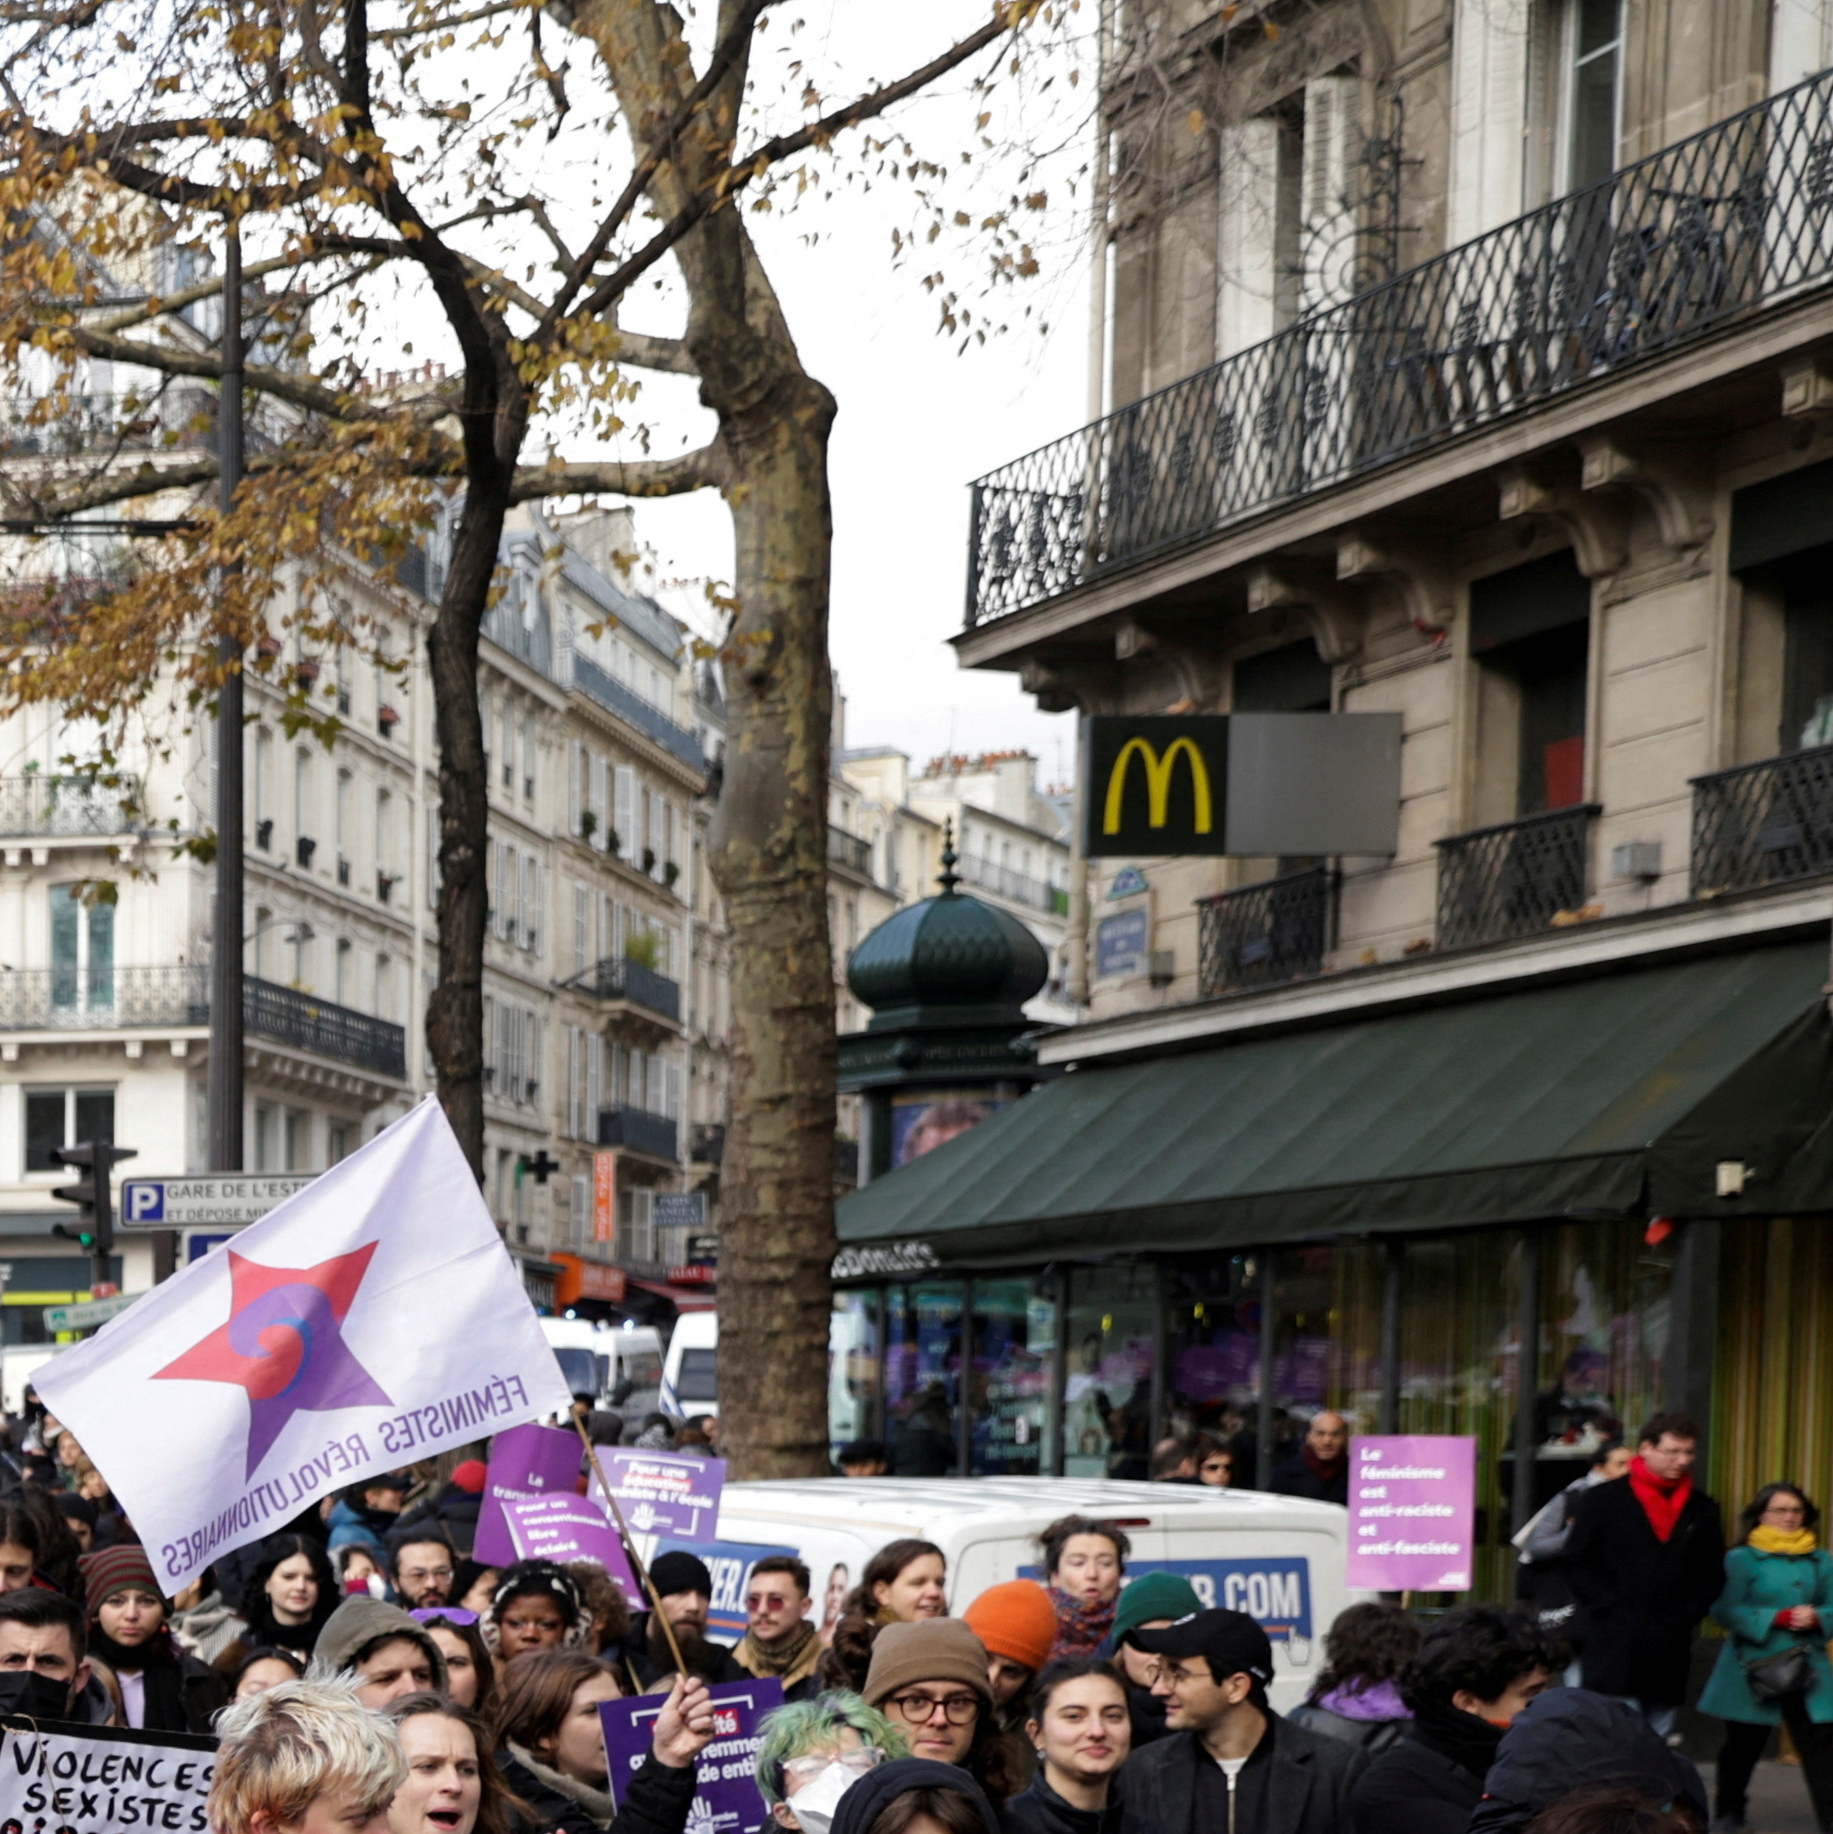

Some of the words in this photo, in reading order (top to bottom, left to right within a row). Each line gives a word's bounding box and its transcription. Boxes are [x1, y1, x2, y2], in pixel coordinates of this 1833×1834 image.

[166, 1184, 215, 1199] GARE
[221, 1184, 245, 1198] DE
[166, 1208, 181, 1221] ET
[186, 1206, 242, 1220] DÉPOSE
[831, 1241, 942, 1279] cDonald's
[1360, 1446, 1382, 1461] Le
[628, 1460, 660, 1477] Pour
[662, 1466, 688, 1479] une
[1360, 1464, 1446, 1480] féminisme
[528, 1472, 544, 1487] La
[1359, 1485, 1387, 1499] est
[1358, 1502, 1454, 1517] anti-raciste
[522, 1512, 608, 1530] consentement
[527, 1529, 559, 1541] libre
[1358, 1523, 1377, 1536] et
[1357, 1539, 1461, 1555] anti-fasciste
[13, 1740, 216, 1796] VIOLENCES
[23, 1782, 208, 1831] SEXISTES
